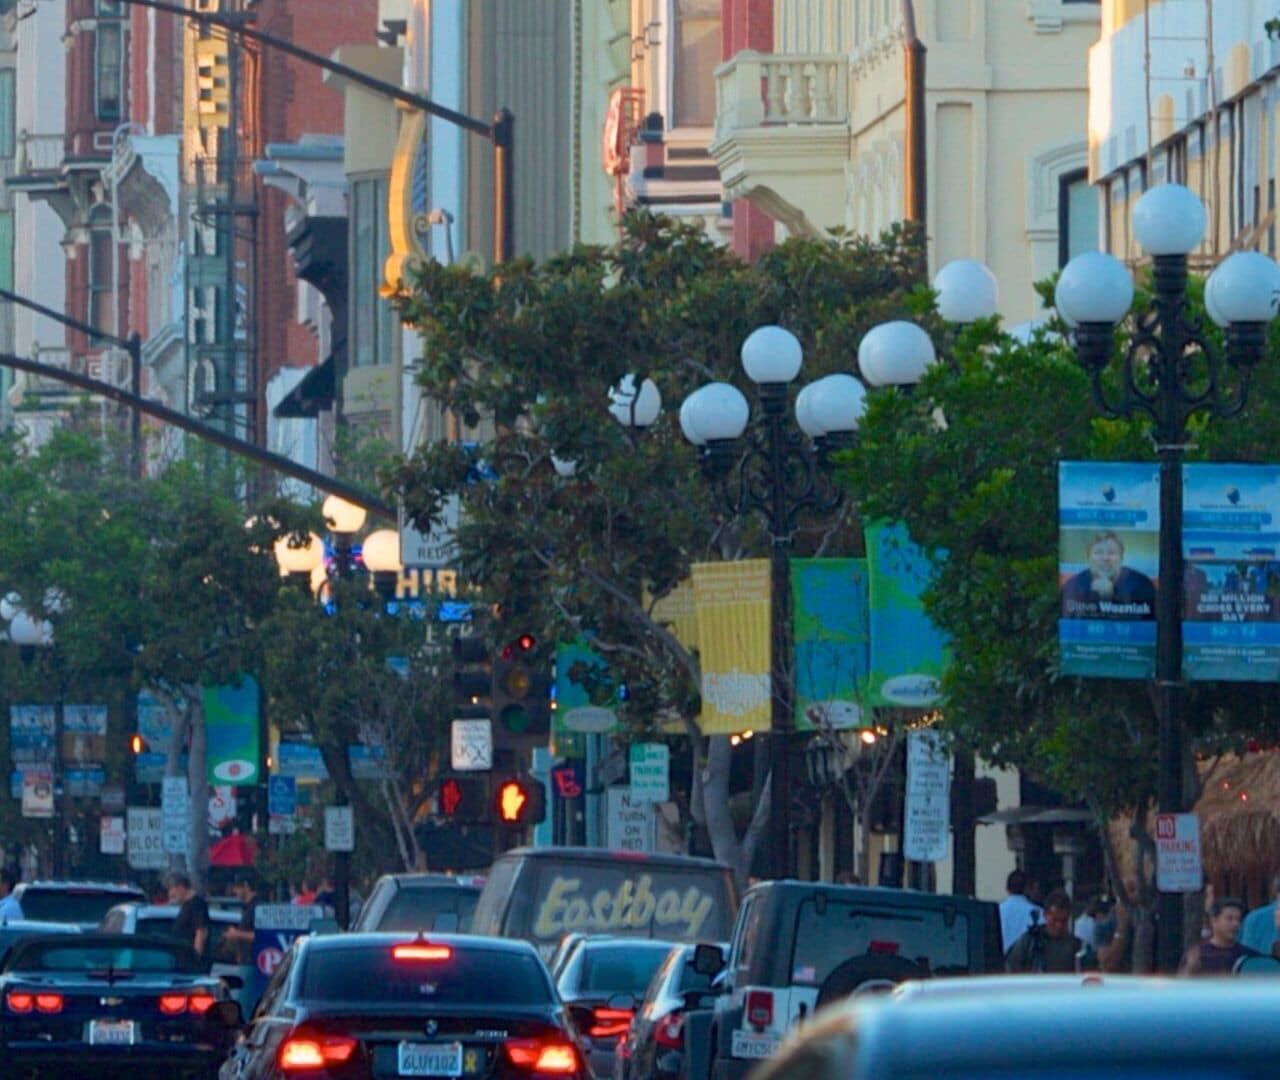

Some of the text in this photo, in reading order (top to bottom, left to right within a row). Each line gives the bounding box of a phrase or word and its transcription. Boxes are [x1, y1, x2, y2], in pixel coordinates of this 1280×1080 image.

[1098, 601, 1151, 615] Wozniak
[1233, 603, 1271, 613] EVERY
[1221, 613, 1247, 623] DAY
[618, 811, 647, 822] TURN
[130, 835, 161, 849] BLOC
[533, 873, 714, 937] Eastbay
